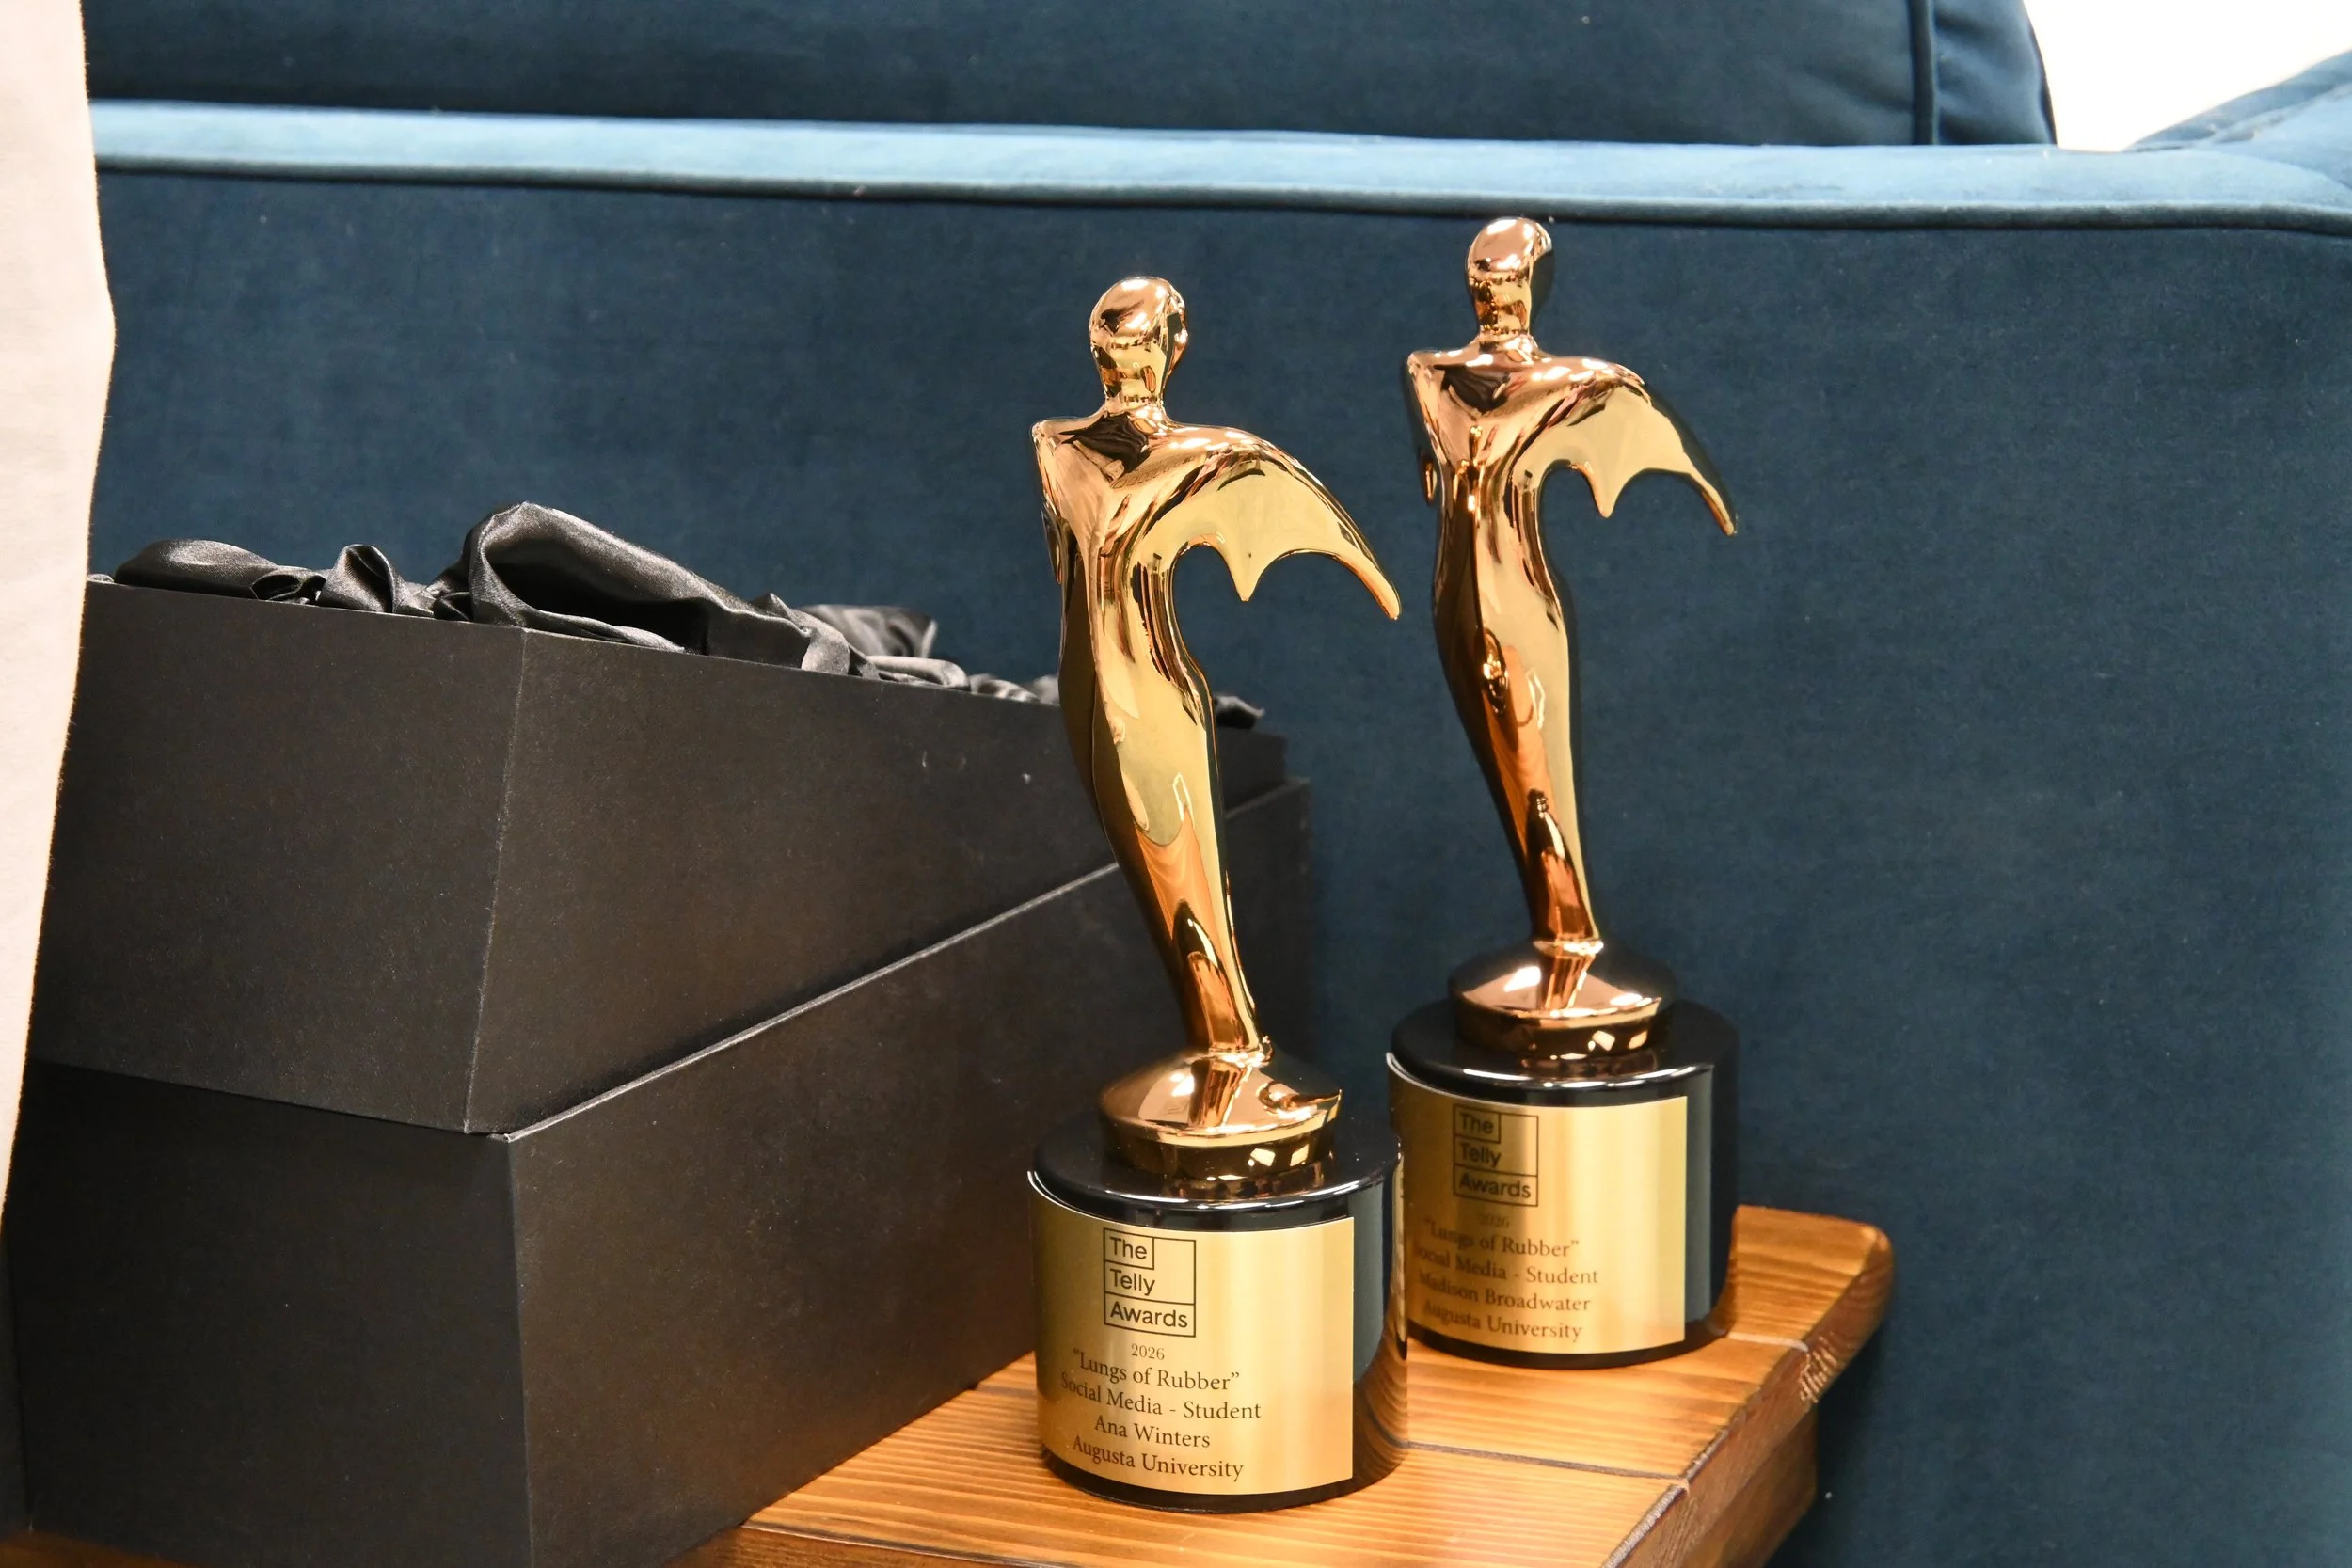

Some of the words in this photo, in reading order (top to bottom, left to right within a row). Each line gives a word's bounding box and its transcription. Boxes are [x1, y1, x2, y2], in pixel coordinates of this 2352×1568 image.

[1460, 1113, 1494, 1134] The
[1460, 1143, 1502, 1168] Telly
[1458, 1176, 1531, 1199] Awards
[1110, 1237, 1147, 1259] The
[1479, 1234, 1497, 1251] of
[1110, 1269, 1154, 1295] Telly
[1454, 1256, 1507, 1280] Media
[1526, 1266, 1597, 1284] Student
[1484, 1287, 1592, 1311] Broadwater
[1110, 1302, 1187, 1328] Awards
[1422, 1298, 1481, 1330] Augusta
[1486, 1317, 1582, 1343] University
[1131, 1343, 1165, 1360] 2026
[1133, 1368, 1152, 1385] of
[1157, 1370, 1240, 1390] Rubber”
[1060, 1372, 1102, 1402] Social
[1106, 1388, 1163, 1415] Media
[1183, 1401, 1262, 1418] Student
[1094, 1415, 1128, 1438] Ana
[1133, 1424, 1211, 1448] Winters
[1072, 1434, 1135, 1467] Augusta
[1142, 1453, 1244, 1482] University
